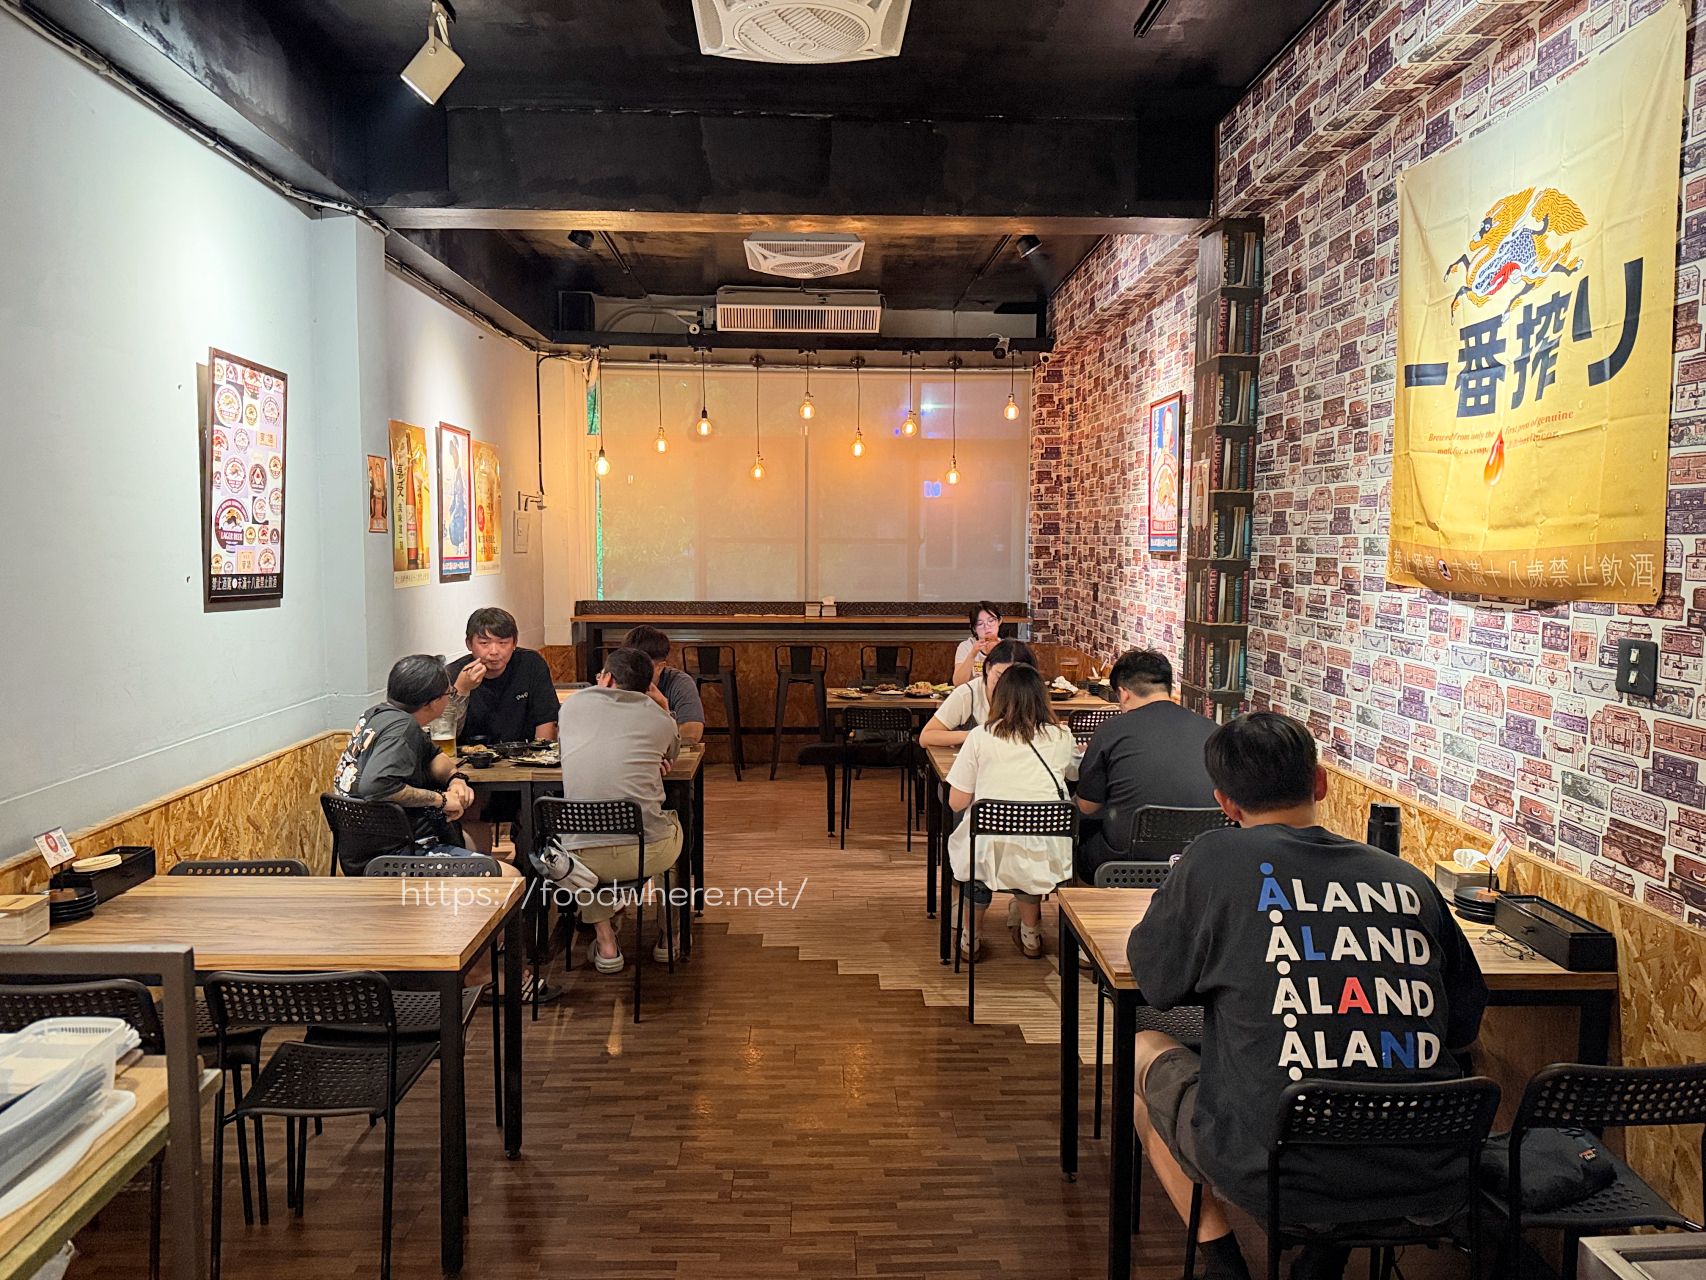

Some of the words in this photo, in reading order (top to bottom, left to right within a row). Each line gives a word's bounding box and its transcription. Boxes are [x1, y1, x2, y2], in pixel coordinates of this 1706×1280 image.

[1404, 257, 1644, 418] 一番搾り
[1537, 411, 1575, 427] genuine
[1452, 553, 1655, 588] 未滿十八歲禁止飲酒
